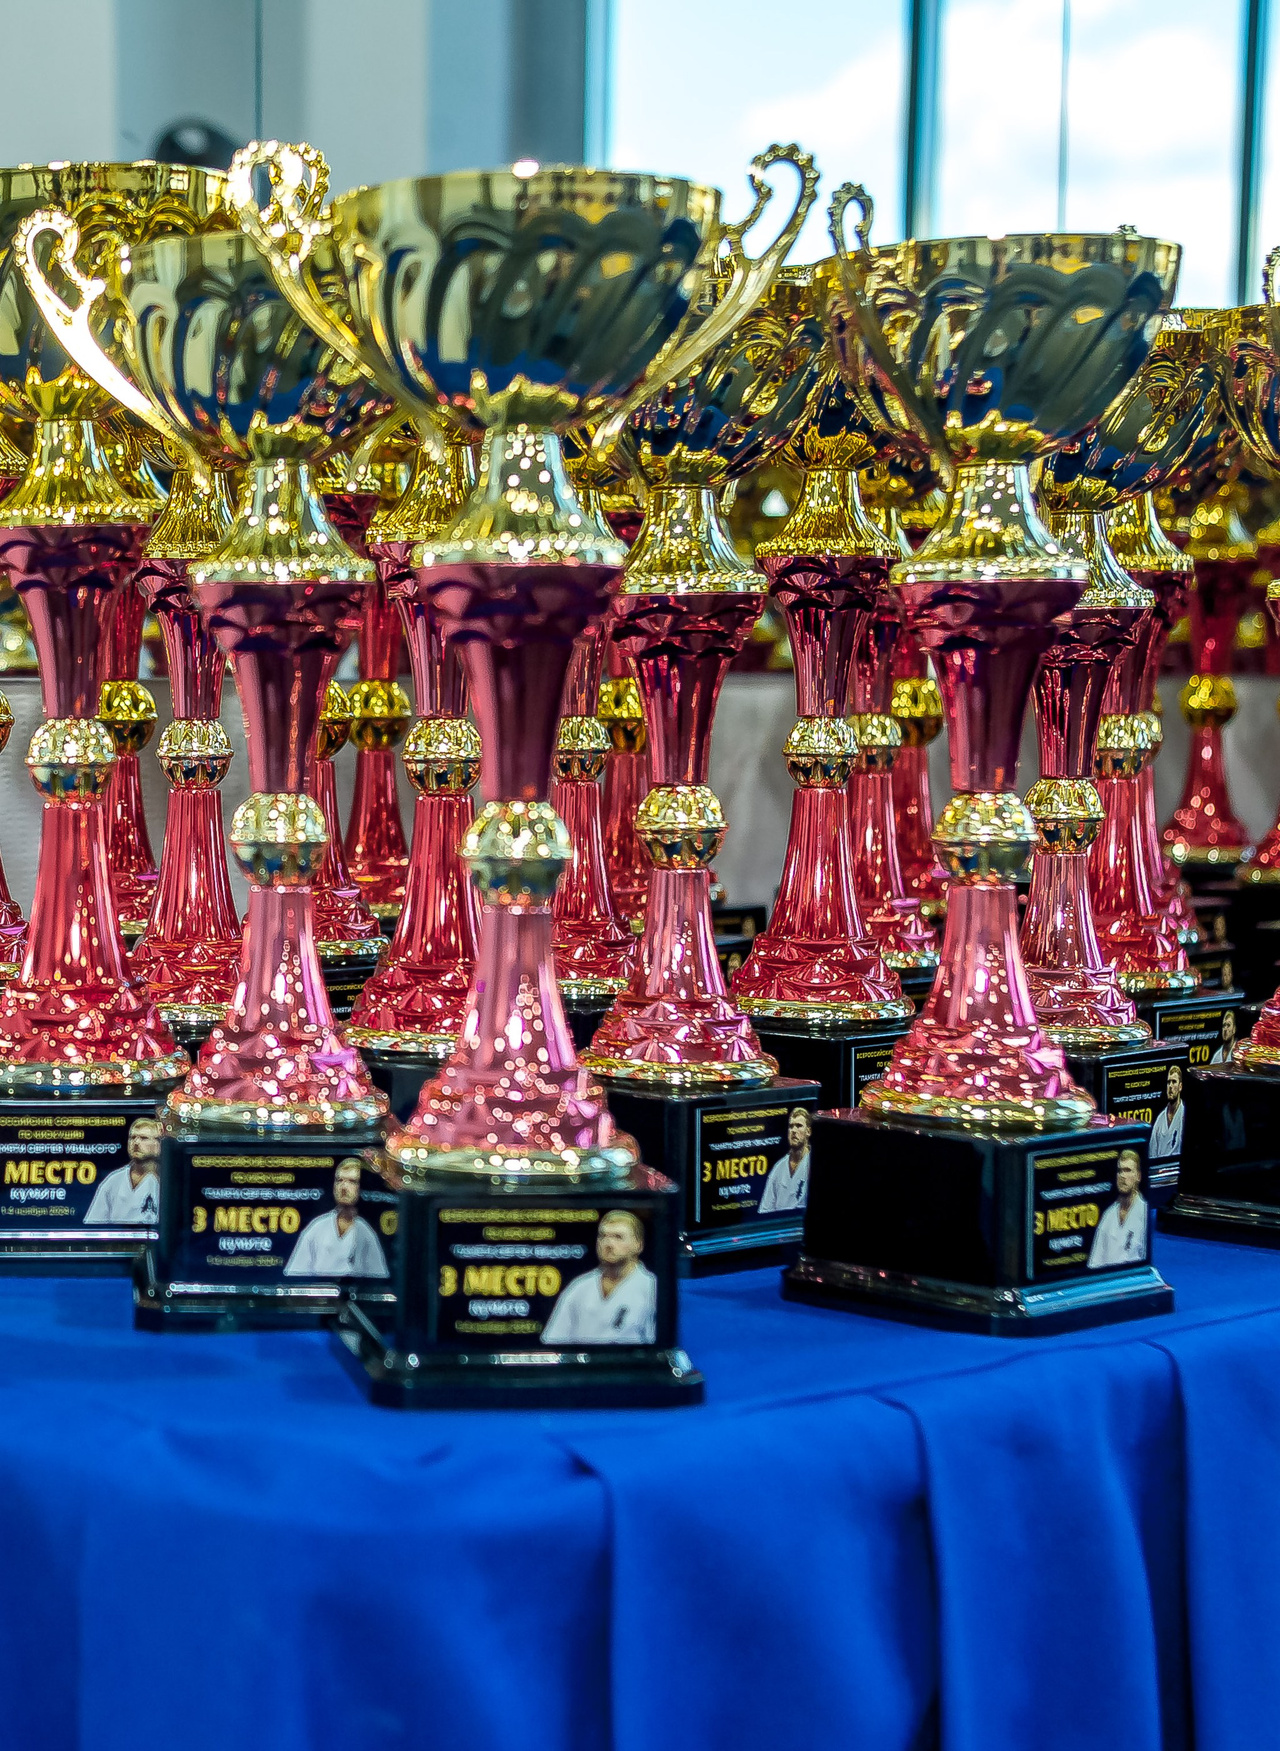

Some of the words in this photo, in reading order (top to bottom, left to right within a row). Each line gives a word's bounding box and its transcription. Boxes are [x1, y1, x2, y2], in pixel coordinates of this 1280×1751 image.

[1189, 1044, 1210, 1063] СТО
[3, 1160, 97, 1185] МЕСТО
[702, 1161, 712, 1183] 3
[716, 1154, 768, 1181] МЕСТО
[191, 1206, 208, 1233] 3
[213, 1206, 301, 1234] МЕСТО
[1033, 1211, 1045, 1235] 3
[438, 1265, 458, 1297] 3
[463, 1265, 562, 1297] МЕСТО
